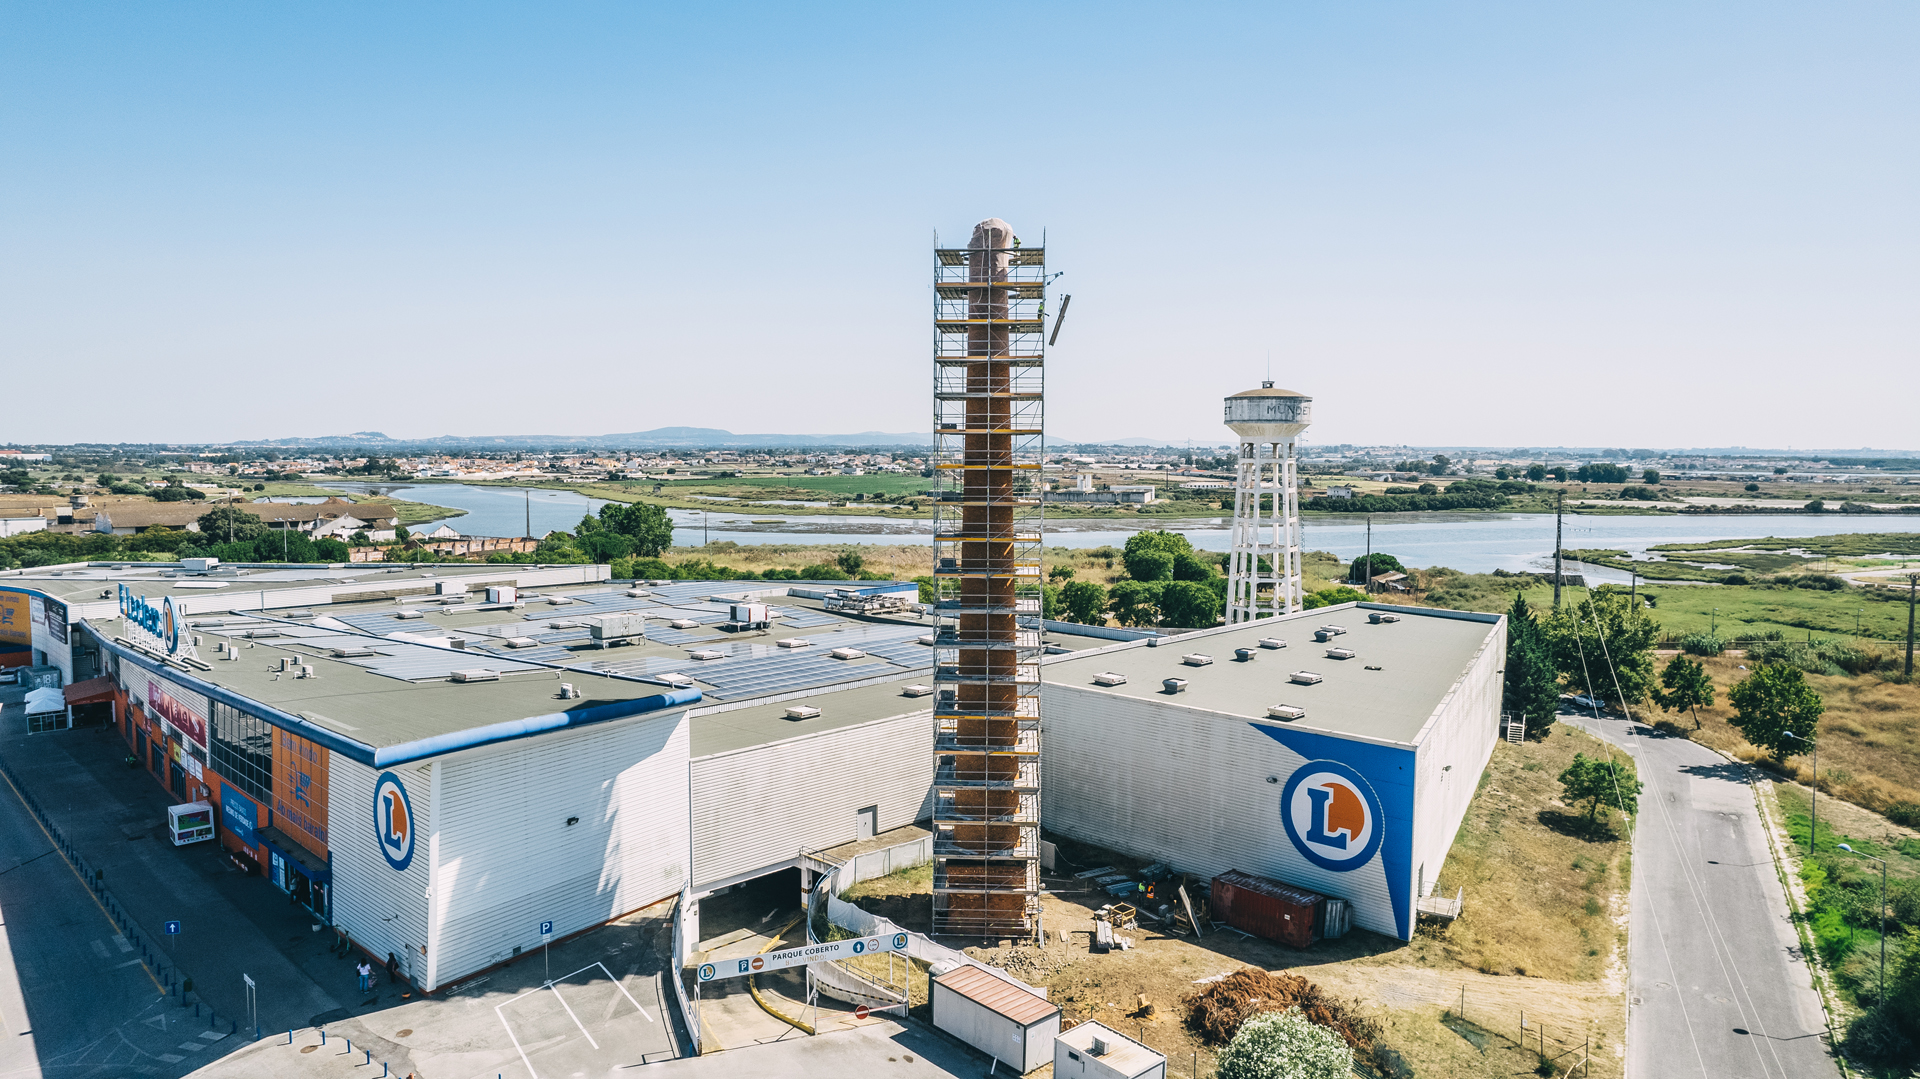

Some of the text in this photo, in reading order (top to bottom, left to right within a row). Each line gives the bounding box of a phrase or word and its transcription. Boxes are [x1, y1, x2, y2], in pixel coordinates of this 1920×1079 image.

[1266, 404, 1311, 415] MUNDET
[282, 732, 318, 763] Bem vindo
[383, 794, 402, 852] L
[1306, 787, 1347, 851] L
[542, 922, 550, 934] P
[772, 944, 840, 961] PARQUE COBERTO
